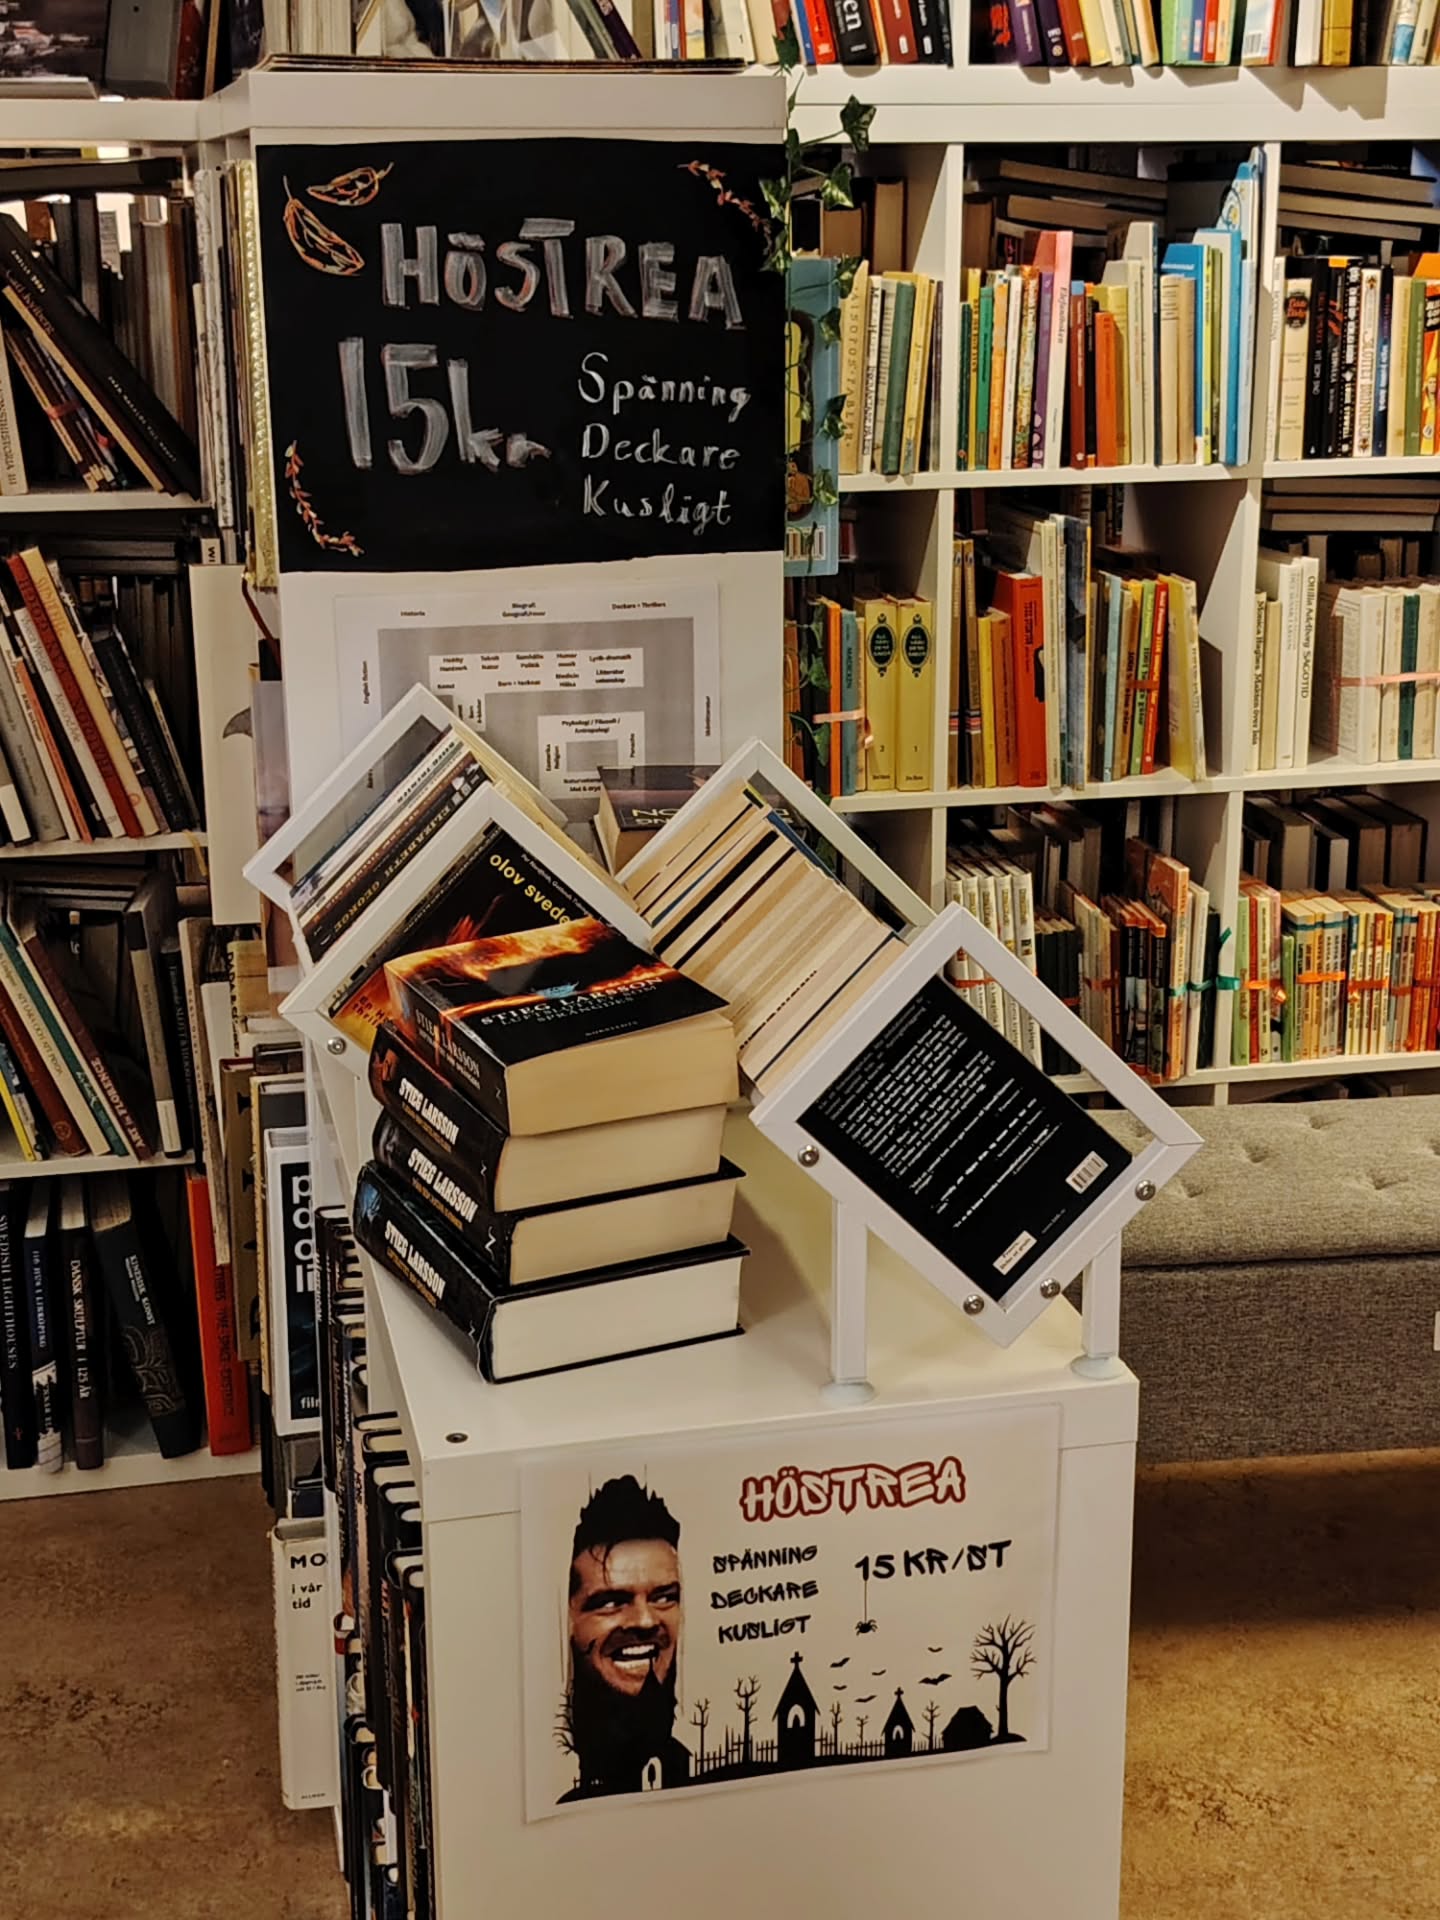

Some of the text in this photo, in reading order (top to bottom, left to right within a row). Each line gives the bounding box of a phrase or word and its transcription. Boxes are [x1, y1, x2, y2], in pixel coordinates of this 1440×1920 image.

[380, 217, 746, 330] HÖSTREA
[577, 352, 752, 422] Spänning
[581, 424, 742, 470] Deckare
[582, 475, 733, 536] Kusligt
[384, 805, 451, 878] ELIZABETH
[489, 853, 526, 887] olov
[480, 976, 663, 1026] STIEG LARSSON
[399, 1077, 424, 1112] STIEG
[421, 1097, 460, 1146] LARSSON
[407, 1147, 438, 1185] STIEG
[432, 1170, 479, 1224] LARSSON
[70, 1259, 83, 1296] DANSK
[384, 1219, 409, 1260] STIEG
[406, 1244, 447, 1300] LARSSON
[2, 1276, 17, 1370] LIGHTHOUSES
[73, 1298, 87, 1351] SKULPTUR
[739, 1456, 967, 1522] HÖSTREA
[290, 1553, 329, 1569] MO
[712, 1545, 819, 1574] SPÄNNING
[855, 1554, 896, 1581] 15
[291, 1597, 312, 1610] tid
[300, 1581, 324, 1594] vår
[710, 1580, 820, 1610] DECKARE
[718, 1615, 812, 1644] KUSLIGT
